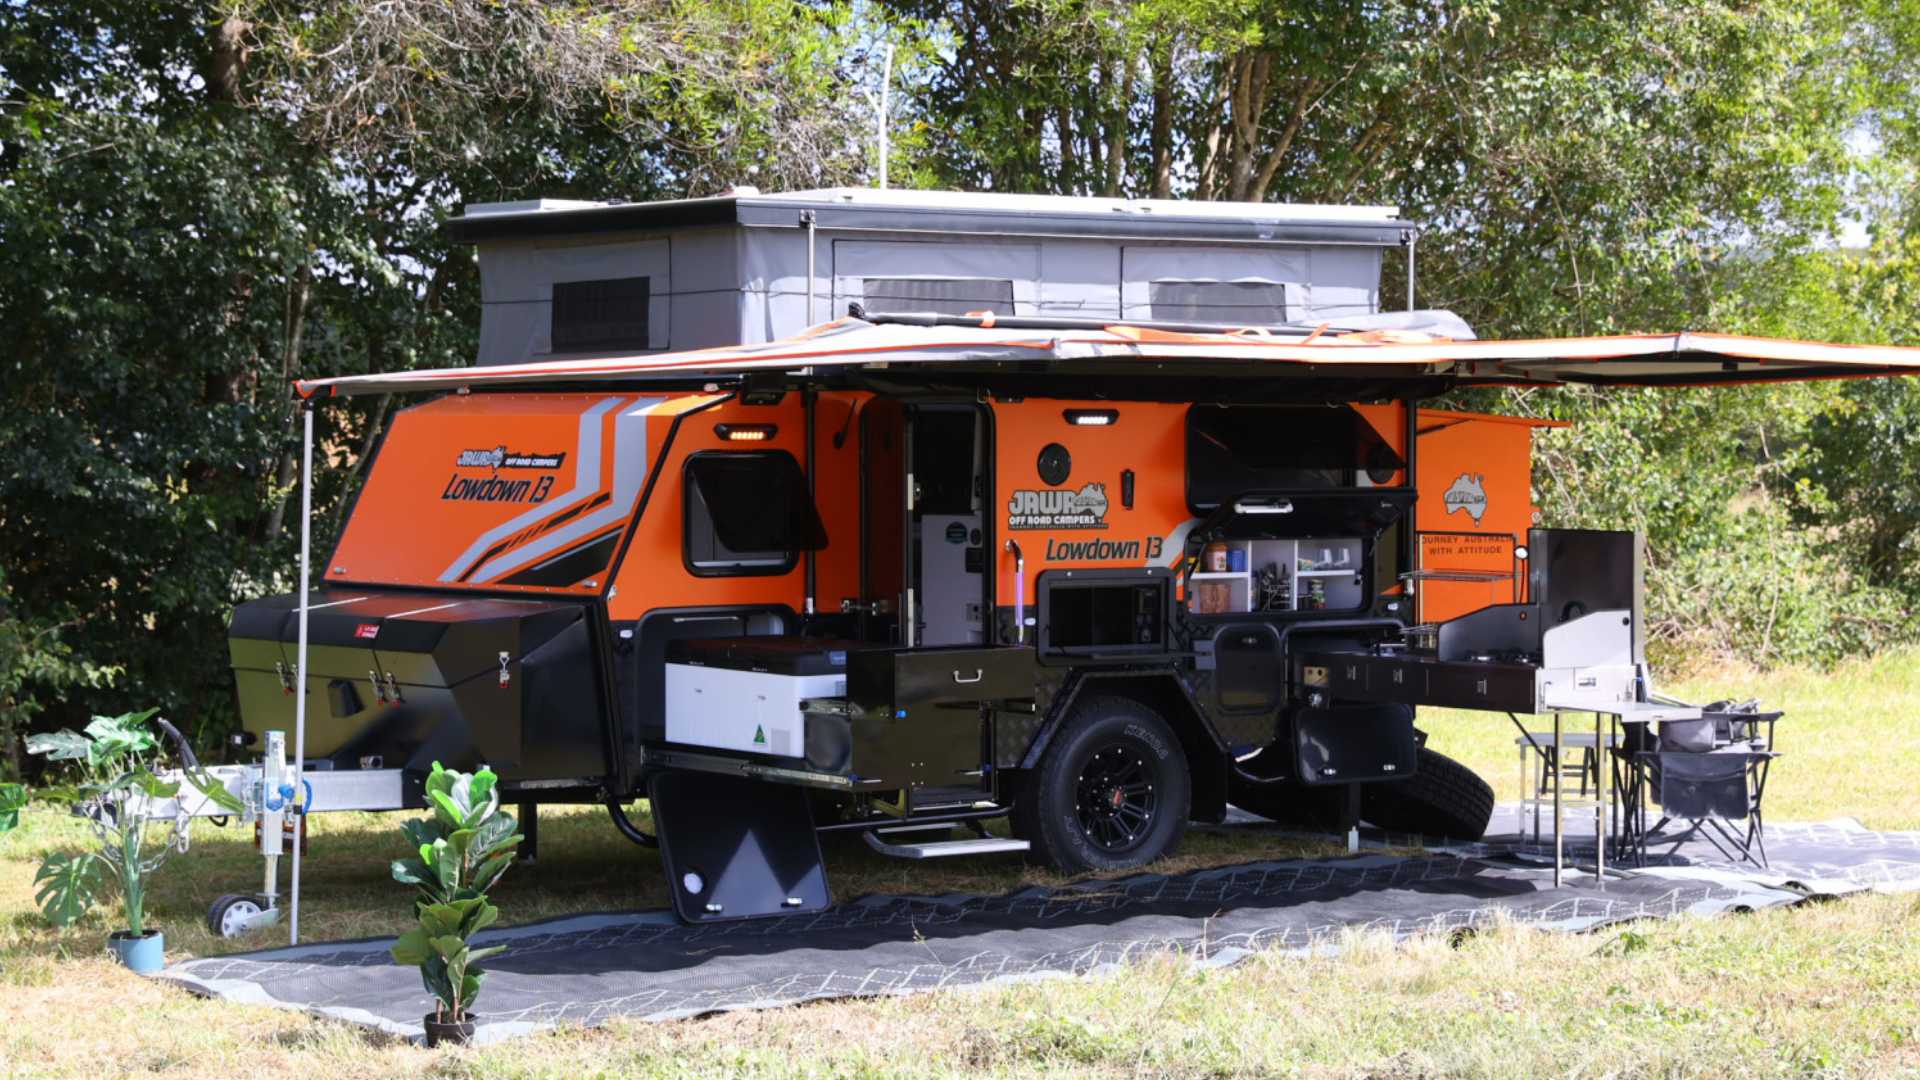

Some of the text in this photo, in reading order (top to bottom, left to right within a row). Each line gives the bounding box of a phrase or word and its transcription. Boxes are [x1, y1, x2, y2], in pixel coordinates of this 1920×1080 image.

[505, 458, 516, 466] OFF
[516, 458, 531, 466] ROAD
[531, 458, 558, 466] CAMPERS
[441, 474, 555, 503] Lowdown 13
[1008, 490, 1079, 515] JAWA
[1008, 515, 1095, 525] OFF ROAD CAMPERS
[1421, 535, 1458, 544] OURNEY
[1046, 537, 1164, 561] Lowdown 13
[1429, 546, 1503, 555] WITH ATTITUDE
